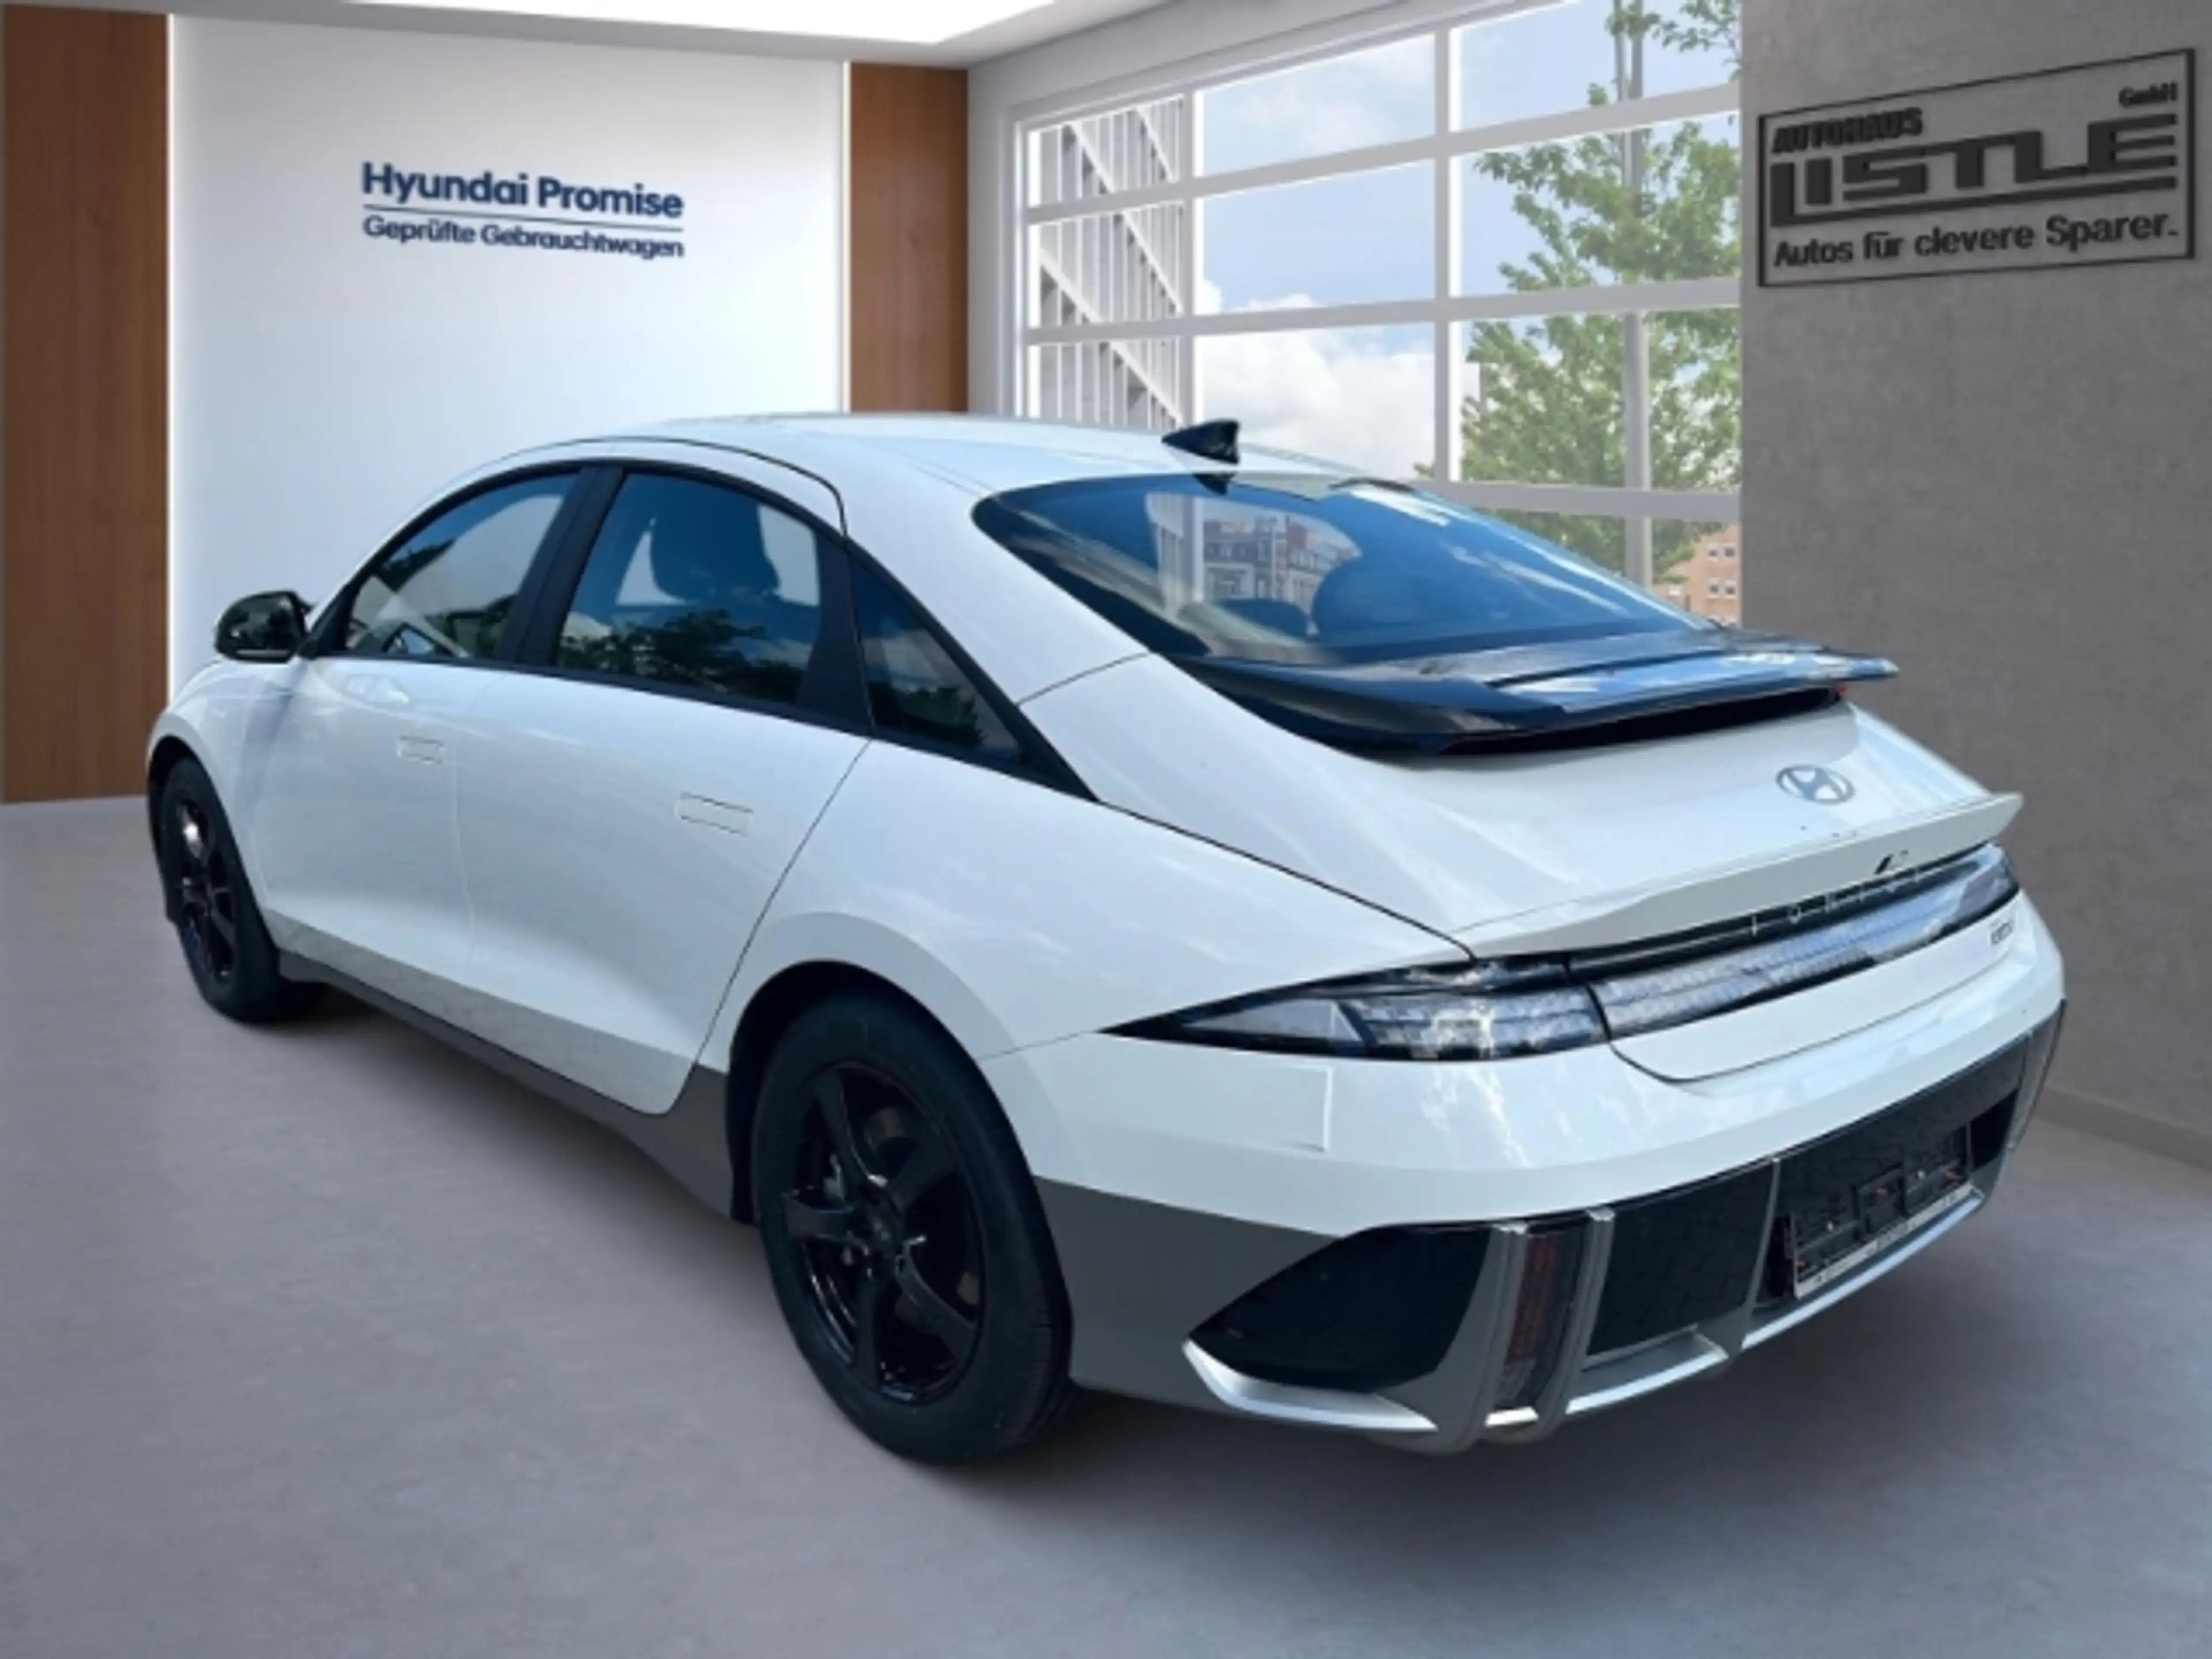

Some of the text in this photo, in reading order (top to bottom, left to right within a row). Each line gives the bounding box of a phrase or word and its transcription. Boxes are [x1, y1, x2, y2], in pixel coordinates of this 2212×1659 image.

[2119, 82, 2178, 108] GmbH
[1772, 108, 1923, 154] AUTOHAUS
[362, 162, 684, 218] Hyundai Promise
[363, 214, 684, 259] Geprüfte Gebrauchtwagen
[1774, 213, 2178, 267] Autos für clevere Sparer.
